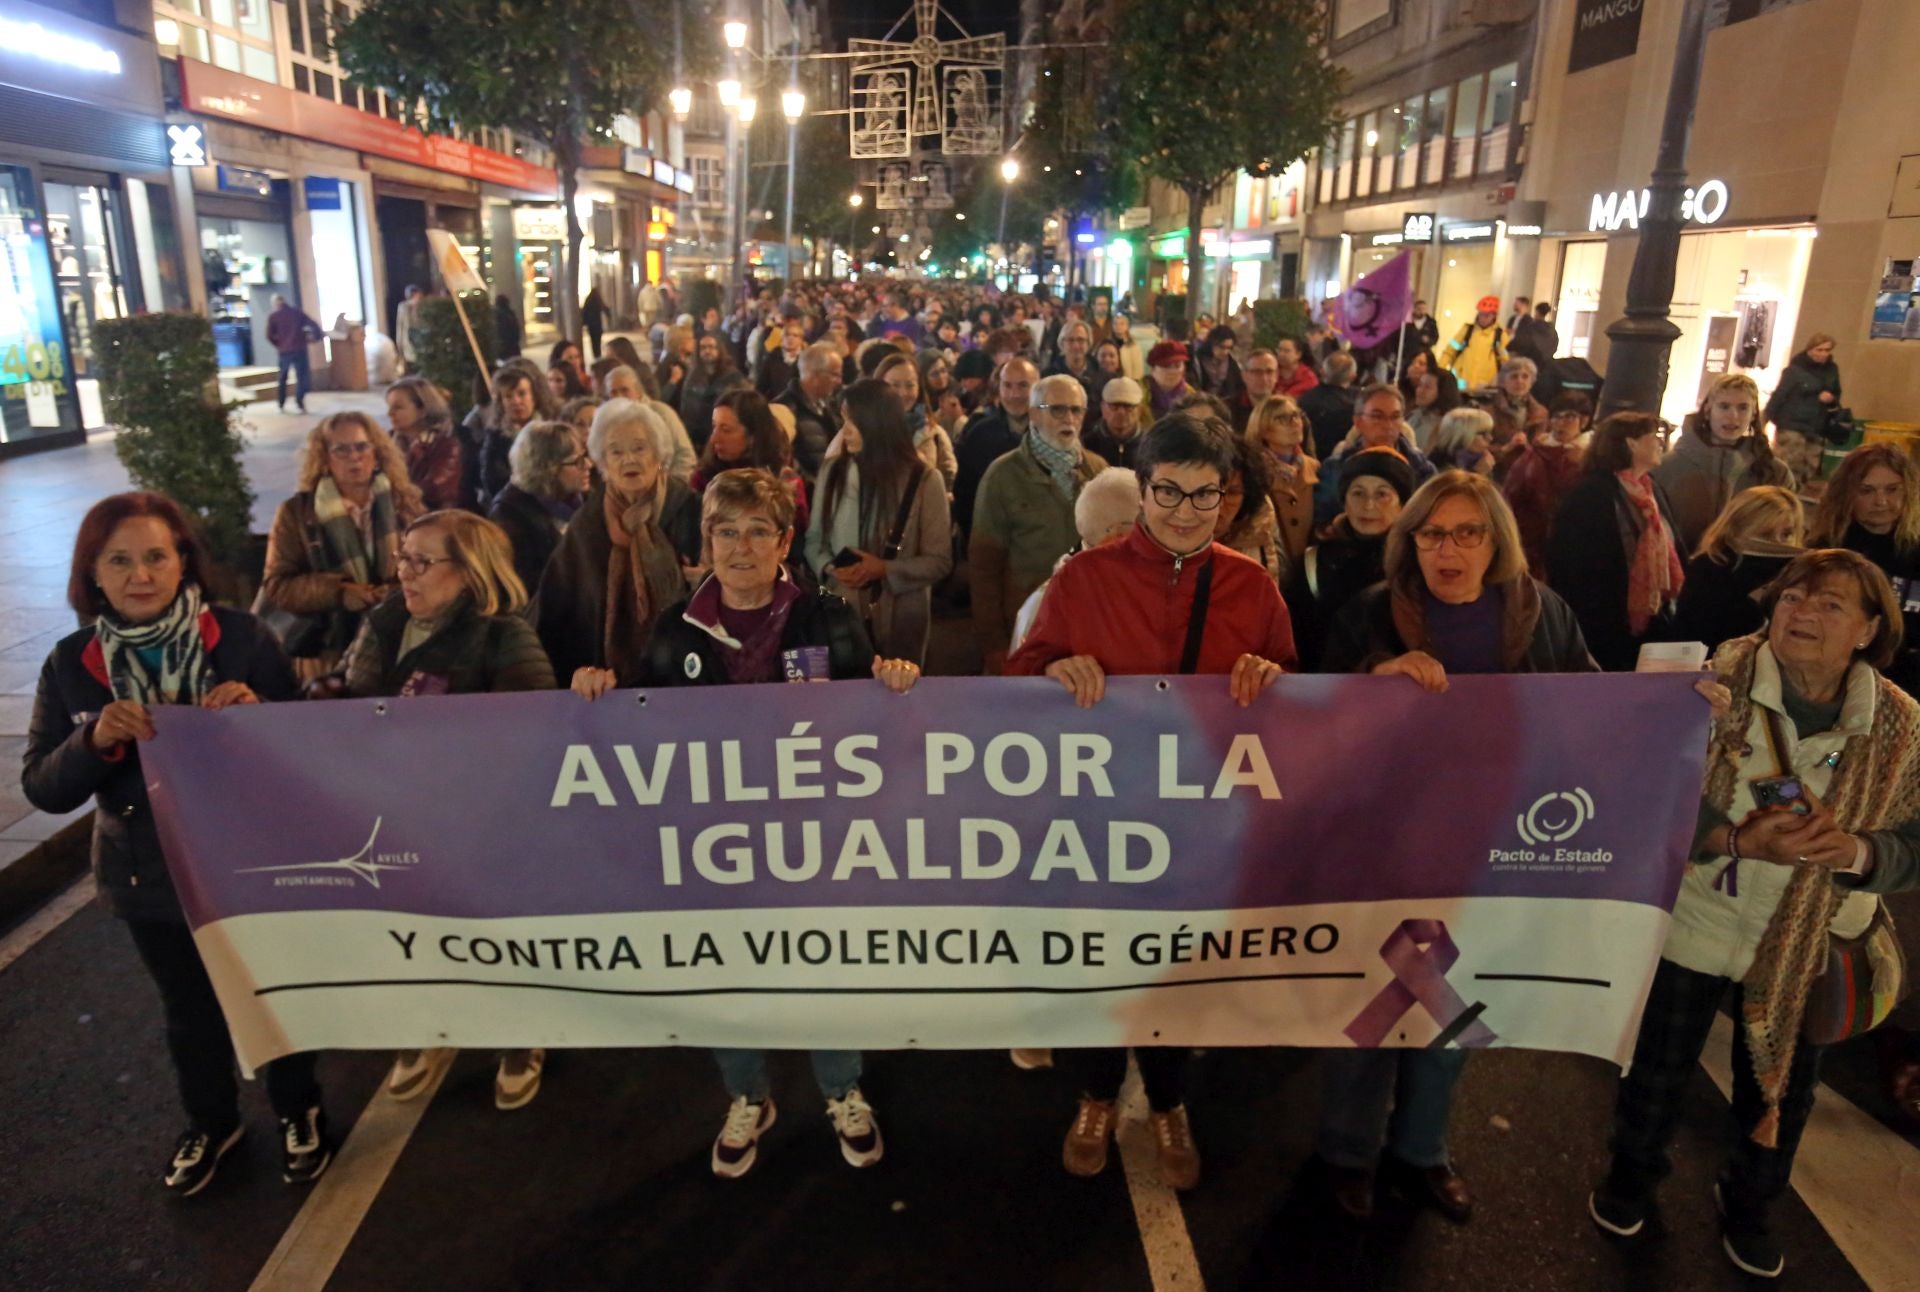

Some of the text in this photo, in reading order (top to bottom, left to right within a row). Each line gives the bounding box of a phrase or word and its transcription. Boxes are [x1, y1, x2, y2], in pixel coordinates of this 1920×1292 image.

[1581, 0, 1640, 30] MANGO
[784, 650, 798, 659] SE
[786, 660, 794, 668] A
[787, 669, 804, 678] CA
[550, 721, 1283, 807] AVILÉS POR LA
[659, 818, 1171, 885] IGUALDAD
[1488, 848, 1613, 862] Pacto de Estado
[273, 876, 354, 887] AYUNTAMIENTO
[388, 923, 1340, 970] Y CONTRA LA VIOLENCIA DE GÉNERO
